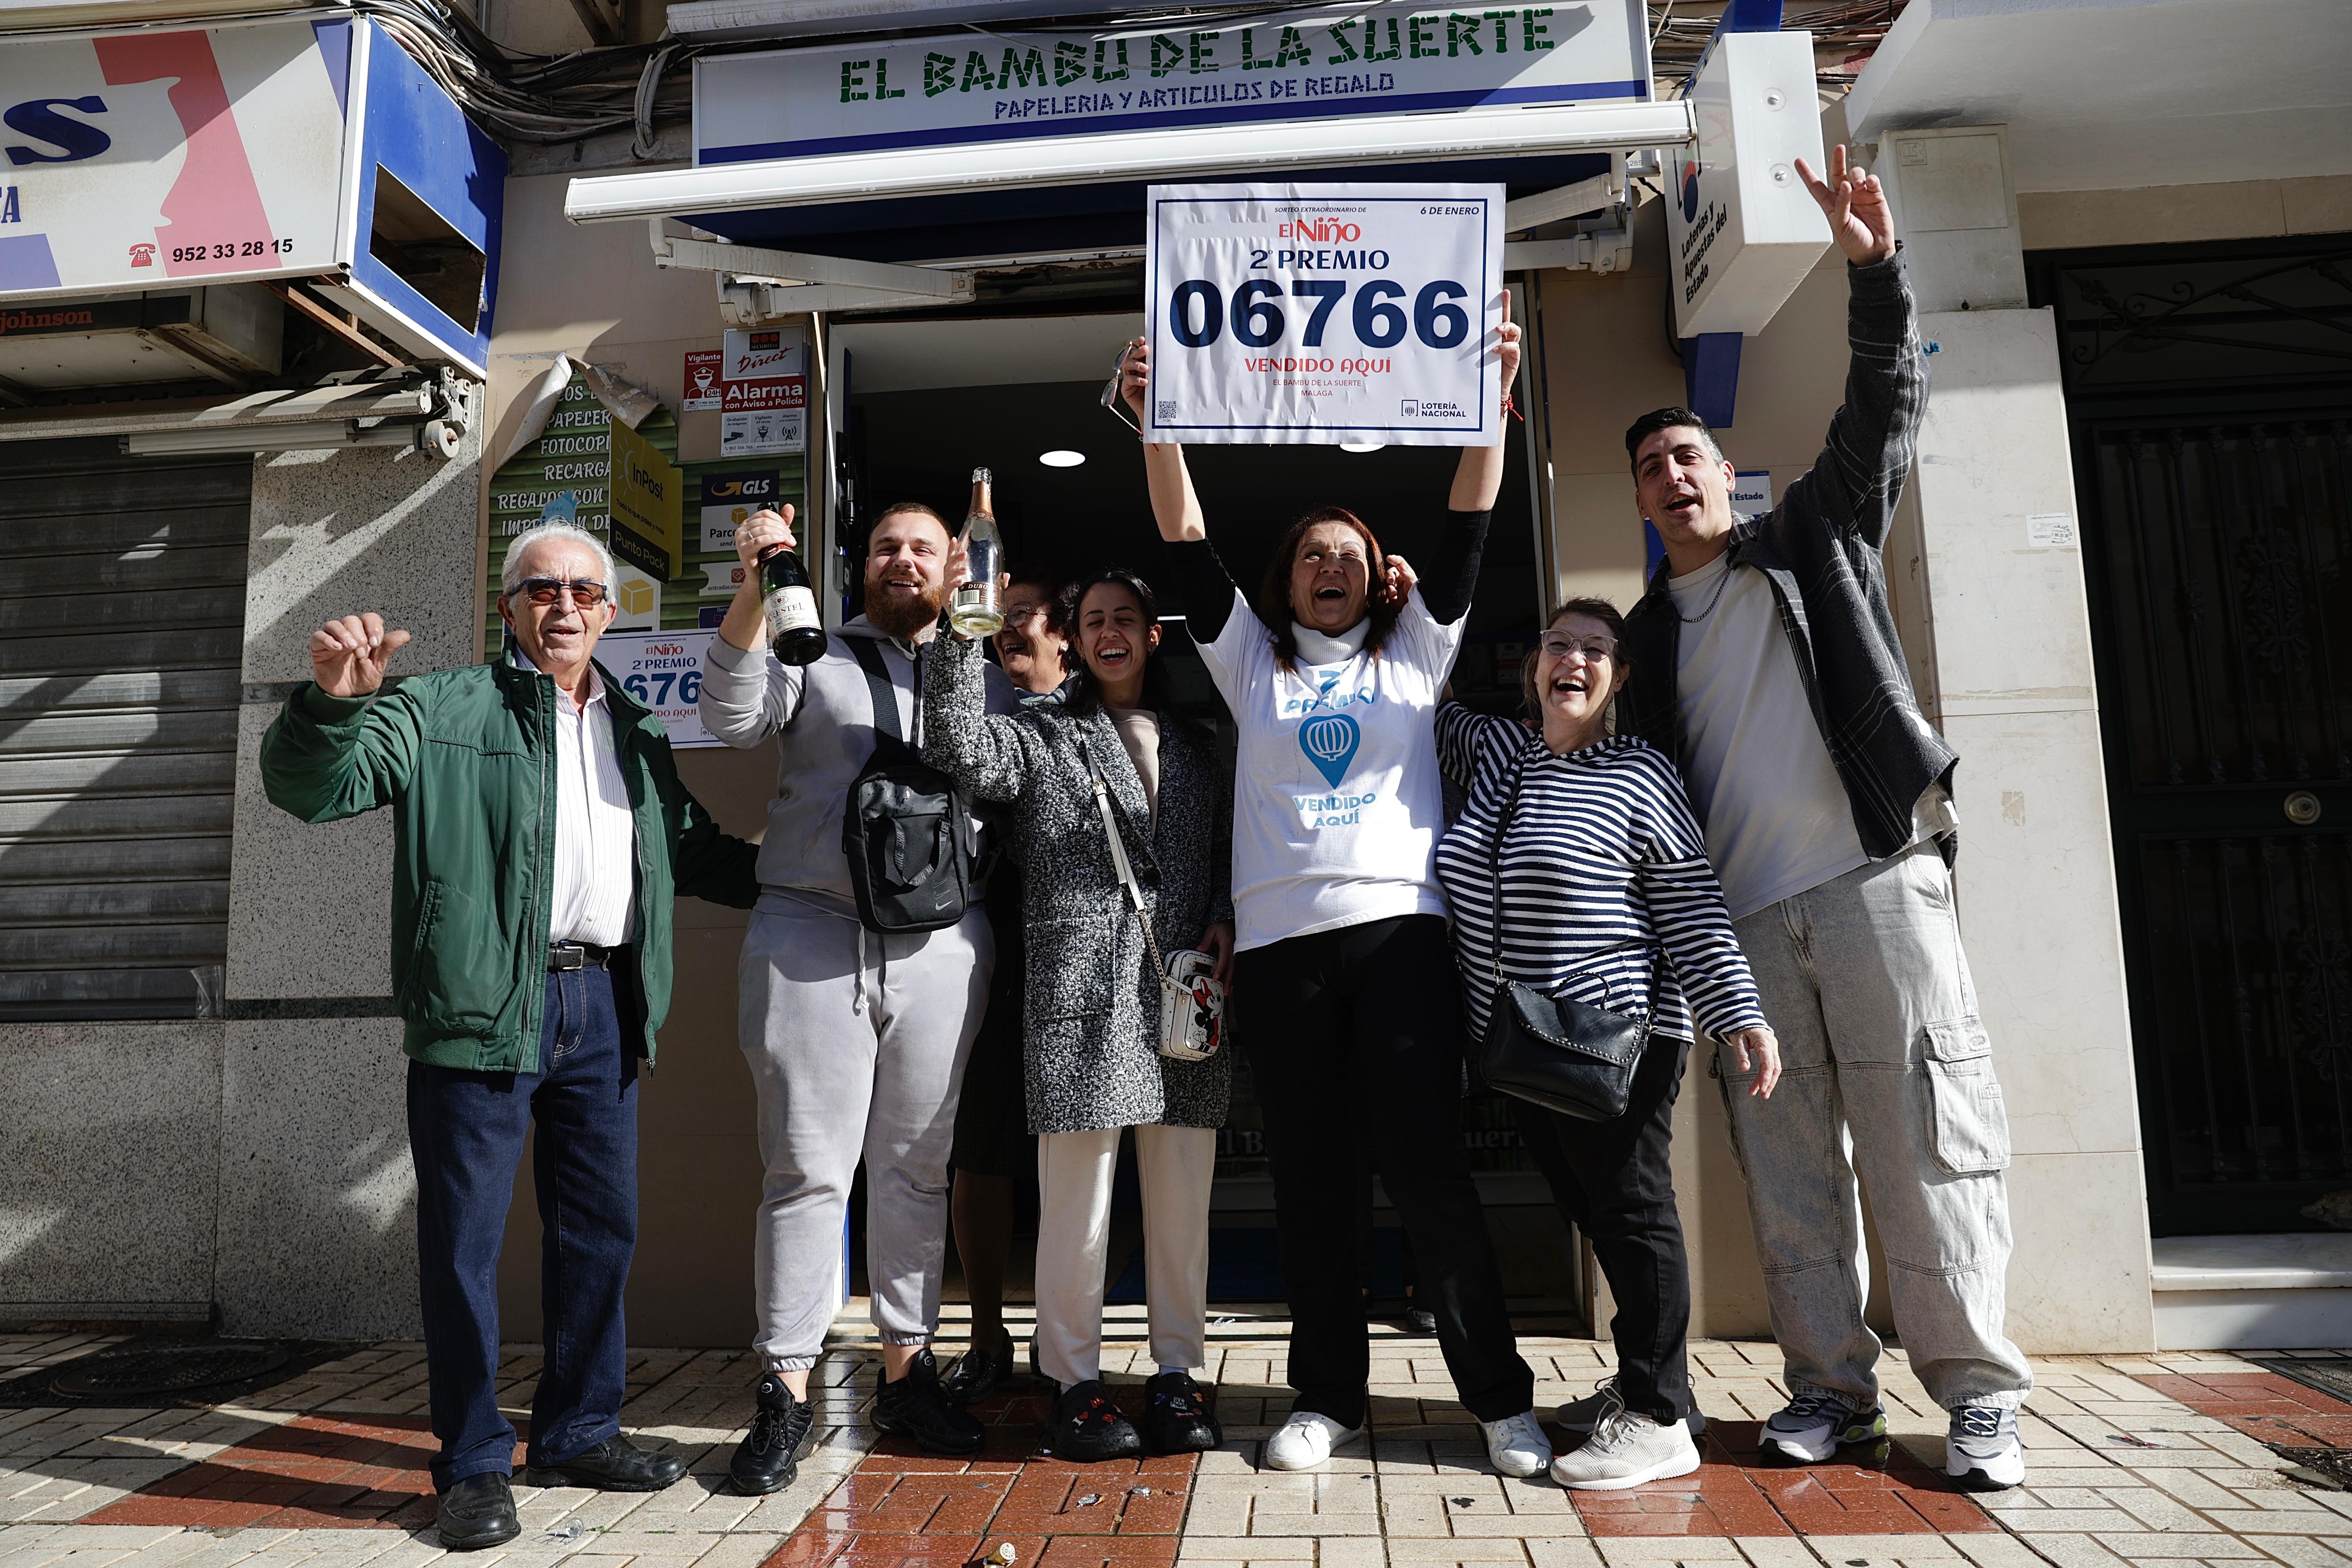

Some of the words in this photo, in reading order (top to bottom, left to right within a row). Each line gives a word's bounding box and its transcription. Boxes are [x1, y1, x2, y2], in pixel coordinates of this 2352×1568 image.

[840, 58, 905, 103] EL
[923, 39, 1130, 97] BAMBU
[1150, 32, 1220, 77] DE
[1242, 26, 1311, 70] LA
[1329, 8, 1554, 65] SUERTE
[995, 93, 1114, 119] PAPELERIA
[1119, 91, 1132, 108] Y
[1138, 81, 1262, 108] ARTICULOS
[1271, 79, 1297, 98] DE
[1305, 73, 1394, 96] REGALO
[4, 96, 111, 165] S
[0, 186, 21, 223] A
[1709, 200, 1713, 222] y
[1297, 217, 1361, 245] Niño
[1685, 227, 1715, 282] Apuestas
[1715, 202, 1727, 234] del
[173, 246, 206, 262] 952
[213, 243, 235, 259] 33
[241, 241, 264, 256] 28
[271, 238, 293, 254] 15
[1278, 250, 1389, 270] PREMIO
[1685, 263, 1708, 305] Estado
[0, 311, 93, 334] johnson
[1170, 279, 1469, 348] 06766
[688, 354, 721, 362] Vigilante
[737, 347, 794, 373] Direct
[1244, 358, 1334, 372] VENDIDO
[1340, 357, 1391, 377] AQUÍ
[726, 383, 803, 400] Alarma
[775, 397, 803, 405] Policía
[633, 463, 663, 502] InPost
[742, 479, 770, 495] GLS
[1735, 492, 1764, 501] Estado
[616, 498, 628, 511] Todo
[628, 505, 632, 514] lo
[632, 509, 640, 519] que
[641, 515, 652, 528] pides
[656, 526, 665, 535] más
[615, 530, 642, 557] Punto
[644, 548, 665, 572] Pack
[654, 643, 684, 656] Niño
[645, 657, 696, 669] PREMIO
[1283, 686, 1374, 713] PREMIO
[1294, 793, 1376, 811] VENDIDO
[1312, 809, 1359, 828] AQUÍ
